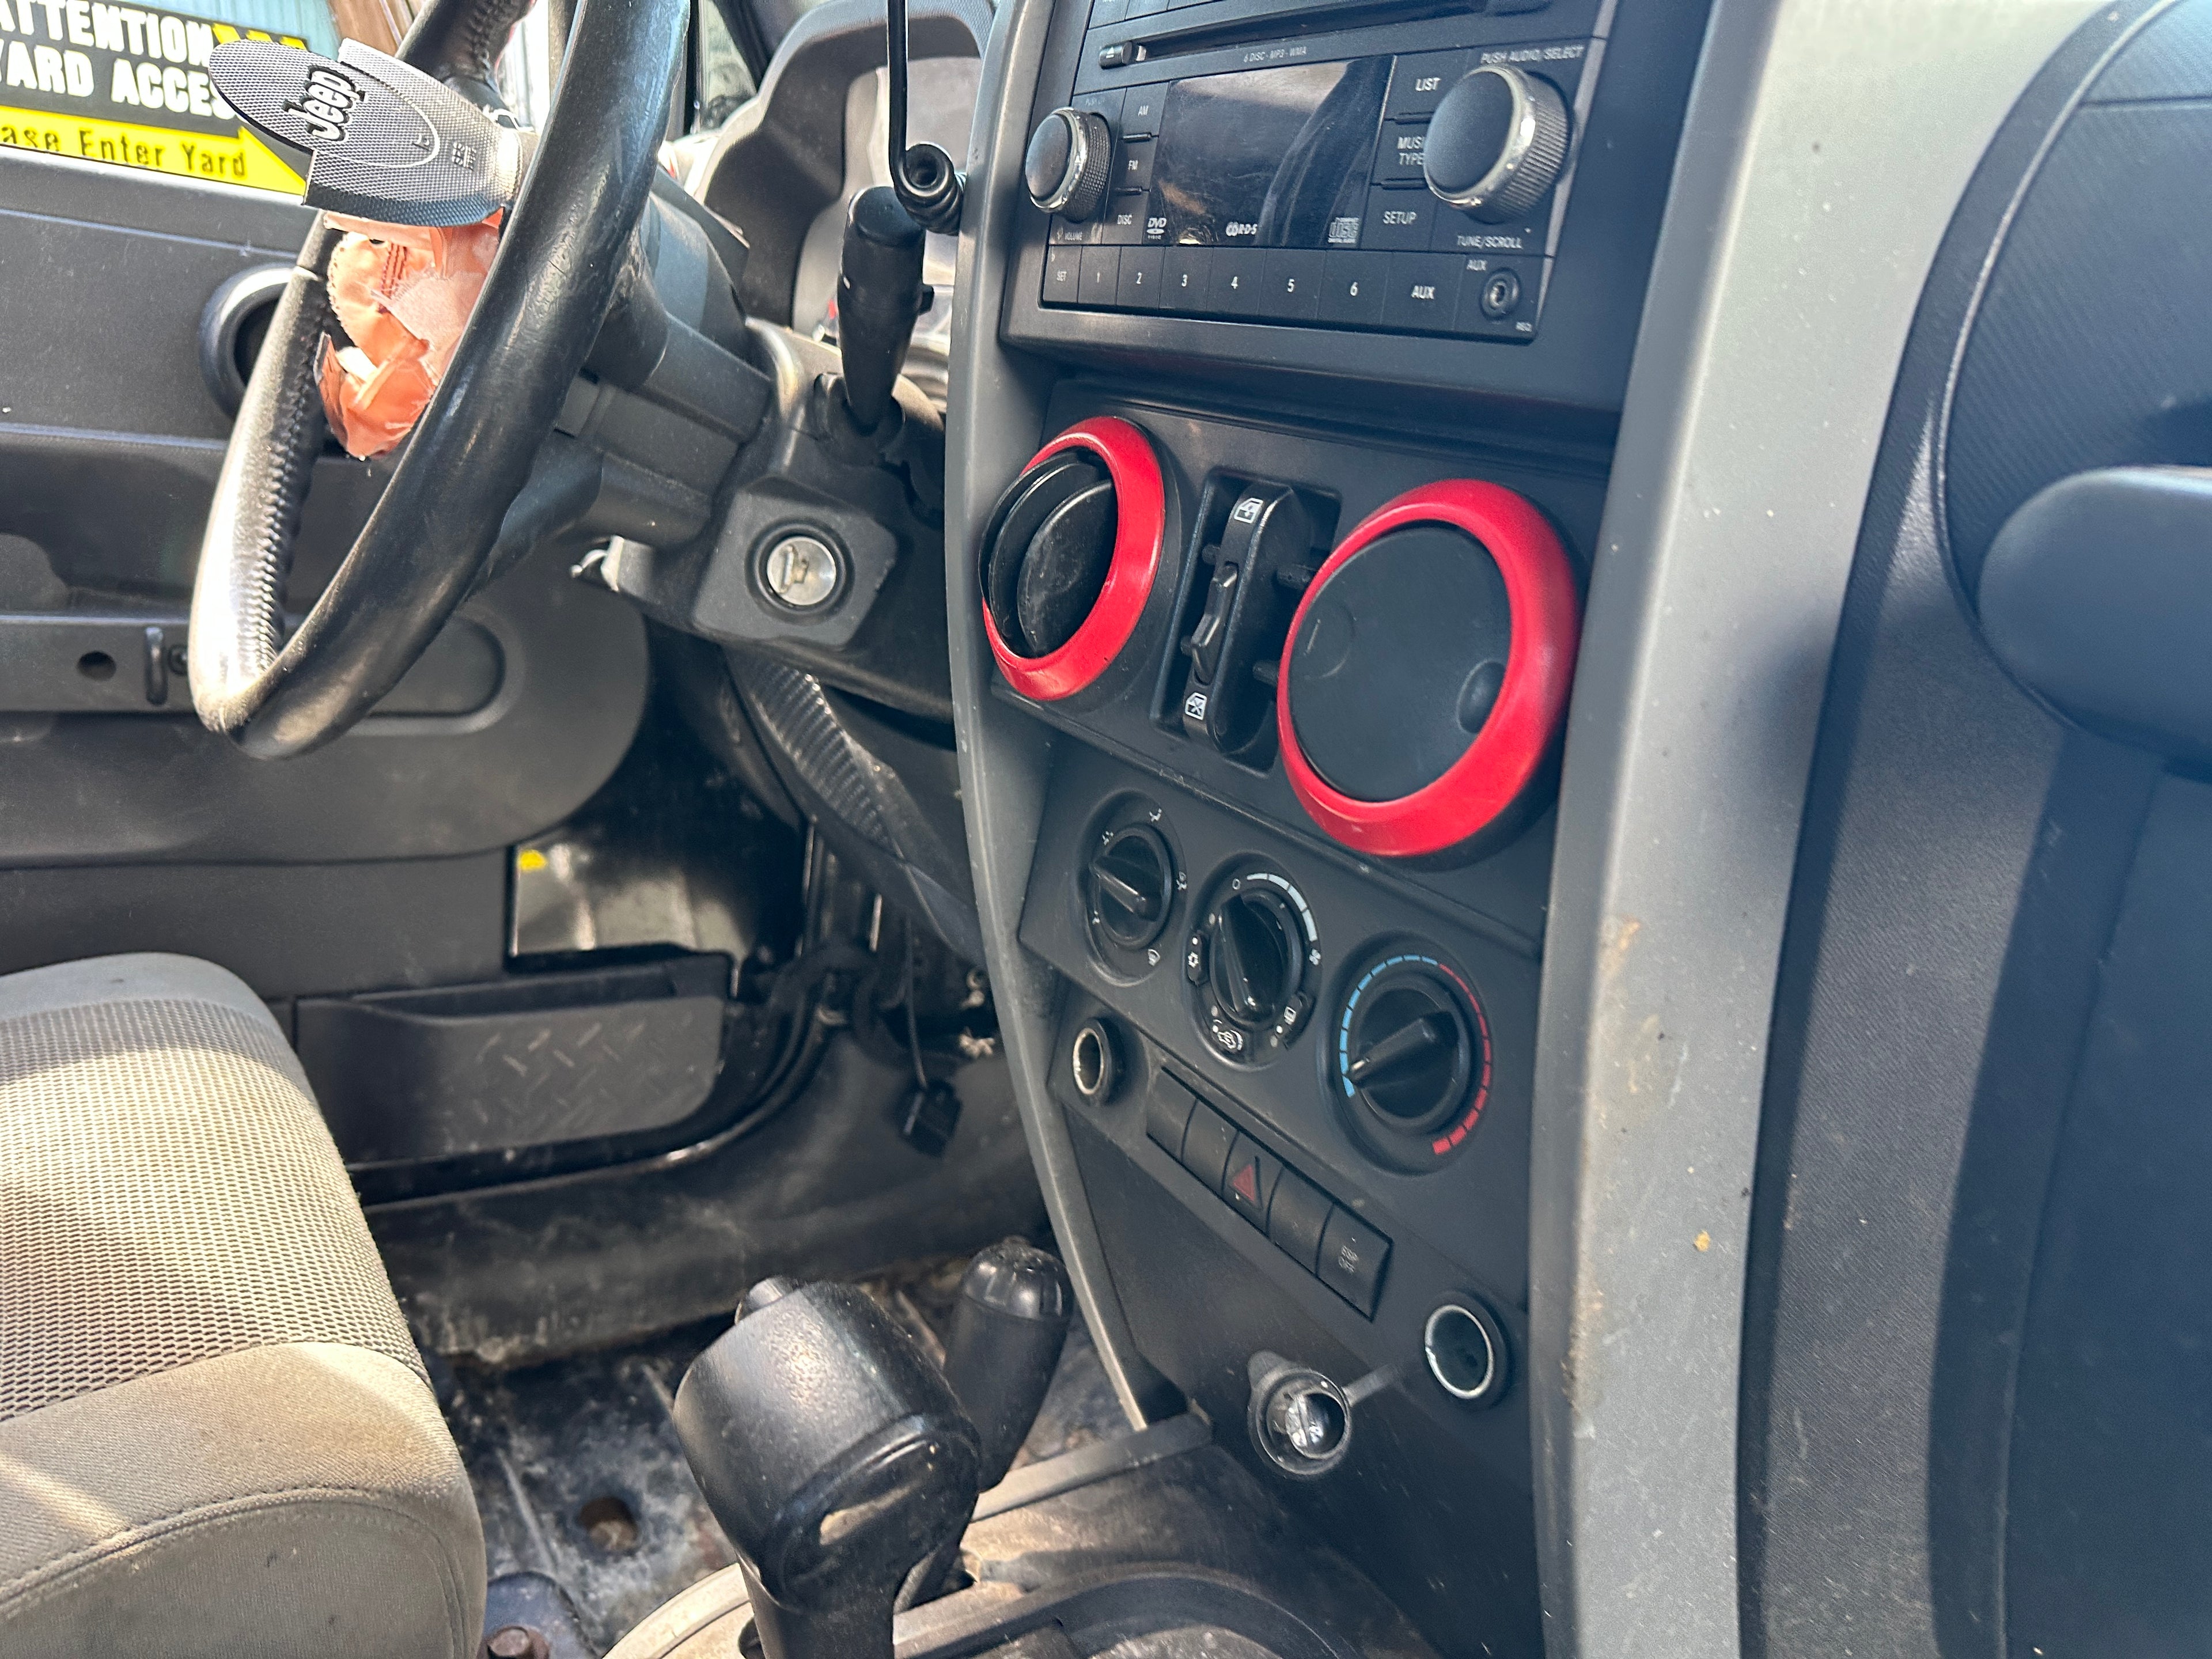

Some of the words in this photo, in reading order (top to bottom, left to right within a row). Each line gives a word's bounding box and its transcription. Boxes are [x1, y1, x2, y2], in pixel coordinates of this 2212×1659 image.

[1249, 51, 1266, 62] DISC
[1289, 46, 1307, 57] WMA
[1481, 52, 1507, 64] PUSH
[0, 38, 94, 97] ARD
[1415, 77, 1440, 91] LIST
[286, 65, 369, 144] Jeep
[1138, 105, 1149, 116] AM
[78, 130, 165, 166] Enter
[181, 143, 247, 177] Yard
[1128, 160, 1138, 171] FM
[1117, 214, 1132, 225] DISC
[1147, 217, 1167, 228] DVD
[1383, 211, 1417, 225] SETUP
[1457, 234, 1523, 249] TUNE/SCROLL
[1467, 260, 1487, 271] AUX
[1056, 270, 1067, 282] SET
[1096, 271, 1100, 283] 1
[1136, 272, 1142, 285] 2
[1181, 274, 1188, 287] 3
[1230, 275, 1238, 290] 4
[1287, 278, 1296, 293] 5
[1350, 282, 1358, 296] 6
[1411, 285, 1435, 300] AUX
